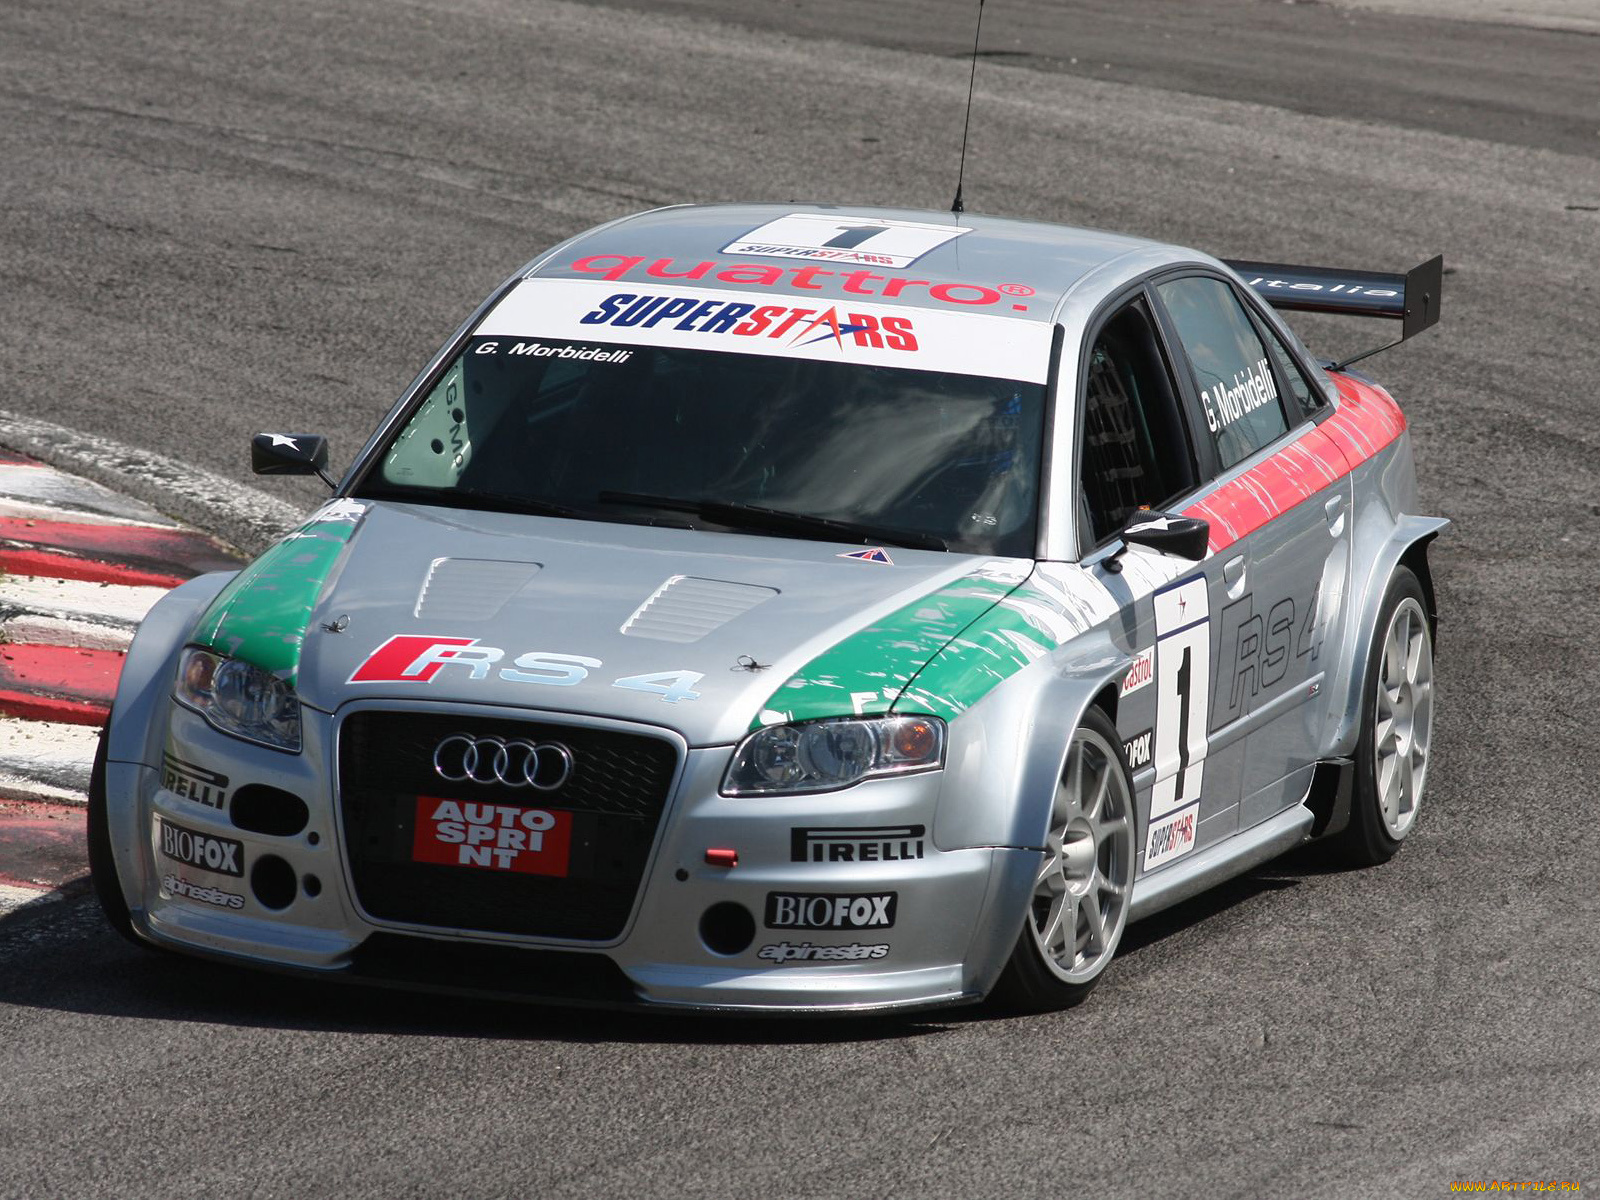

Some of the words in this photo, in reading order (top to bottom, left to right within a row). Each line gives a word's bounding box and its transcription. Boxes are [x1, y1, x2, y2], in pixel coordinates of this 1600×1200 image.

[820, 225, 891, 249] 1
[741, 245, 893, 265] SUPERSTARS
[1249, 277, 1397, 297] Italia
[580, 292, 919, 353] SUPERSTARS
[475, 341, 497, 354] G.
[508, 342, 634, 364] Morbidelli
[1201, 391, 1220, 433] G.
[1212, 357, 1278, 425] Morbidelli
[1174, 645, 1192, 802] 1
[430, 800, 556, 831] AUTO
[163, 823, 239, 873] BIOFOX
[435, 821, 544, 852] SPRI
[790, 824, 926, 862] PIRELLI
[1148, 813, 1194, 860] SUPERSTARS
[458, 844, 519, 869] NT
[162, 873, 246, 910] alpinestars
[772, 896, 892, 926] BIOFOX
[757, 941, 891, 964] alpinestars
